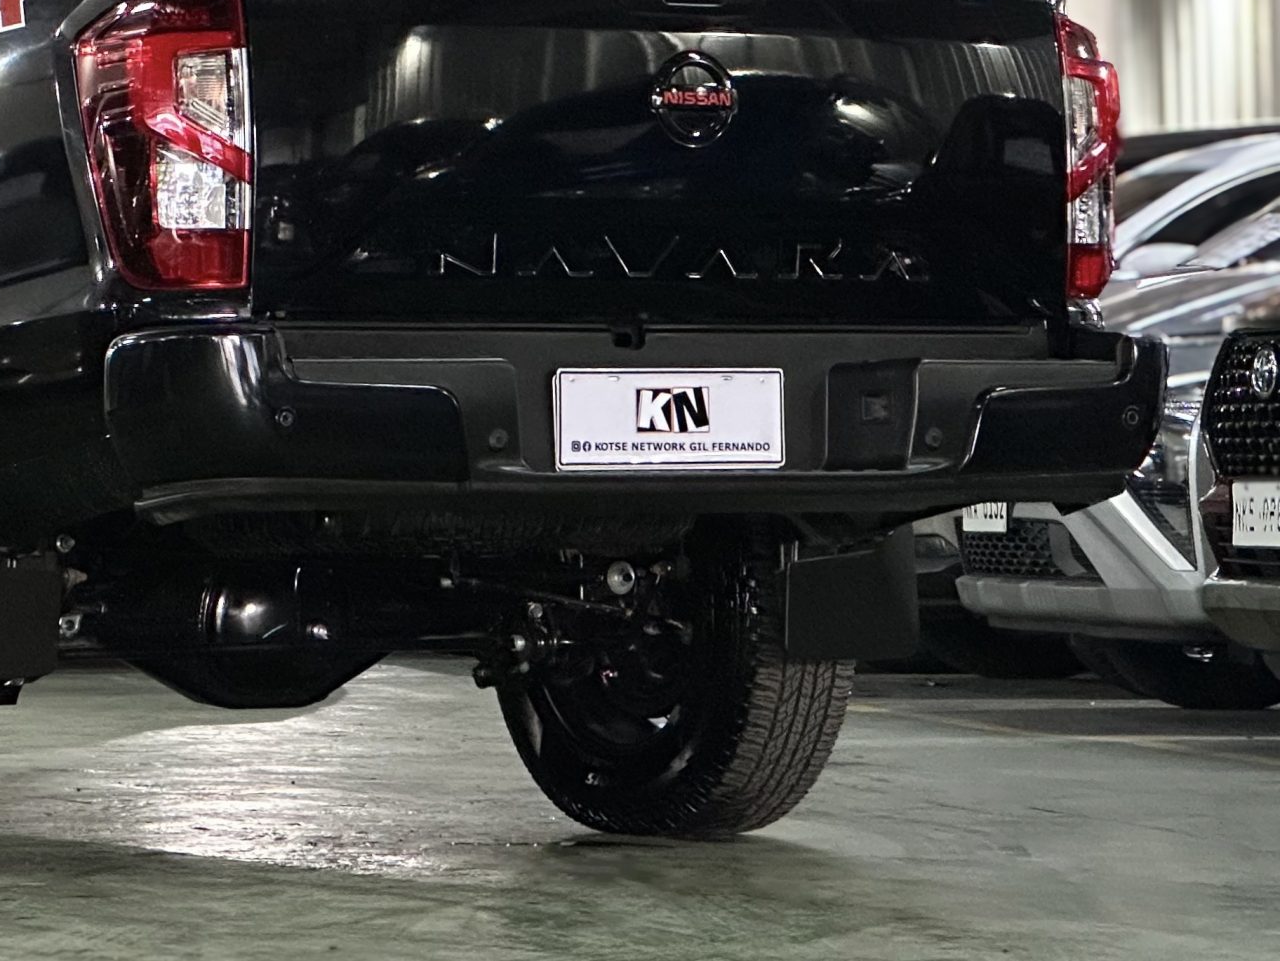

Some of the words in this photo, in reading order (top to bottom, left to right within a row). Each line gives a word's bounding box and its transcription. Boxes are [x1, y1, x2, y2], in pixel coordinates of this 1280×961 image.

[663, 90, 731, 107] NISSAN
[426, 232, 930, 280] NAVARA
[637, 388, 710, 432] KN
[595, 442, 628, 452] KOTSE
[632, 442, 686, 452] NETWORK
[690, 442, 709, 452] GIL
[712, 442, 771, 452] FERNANDO
